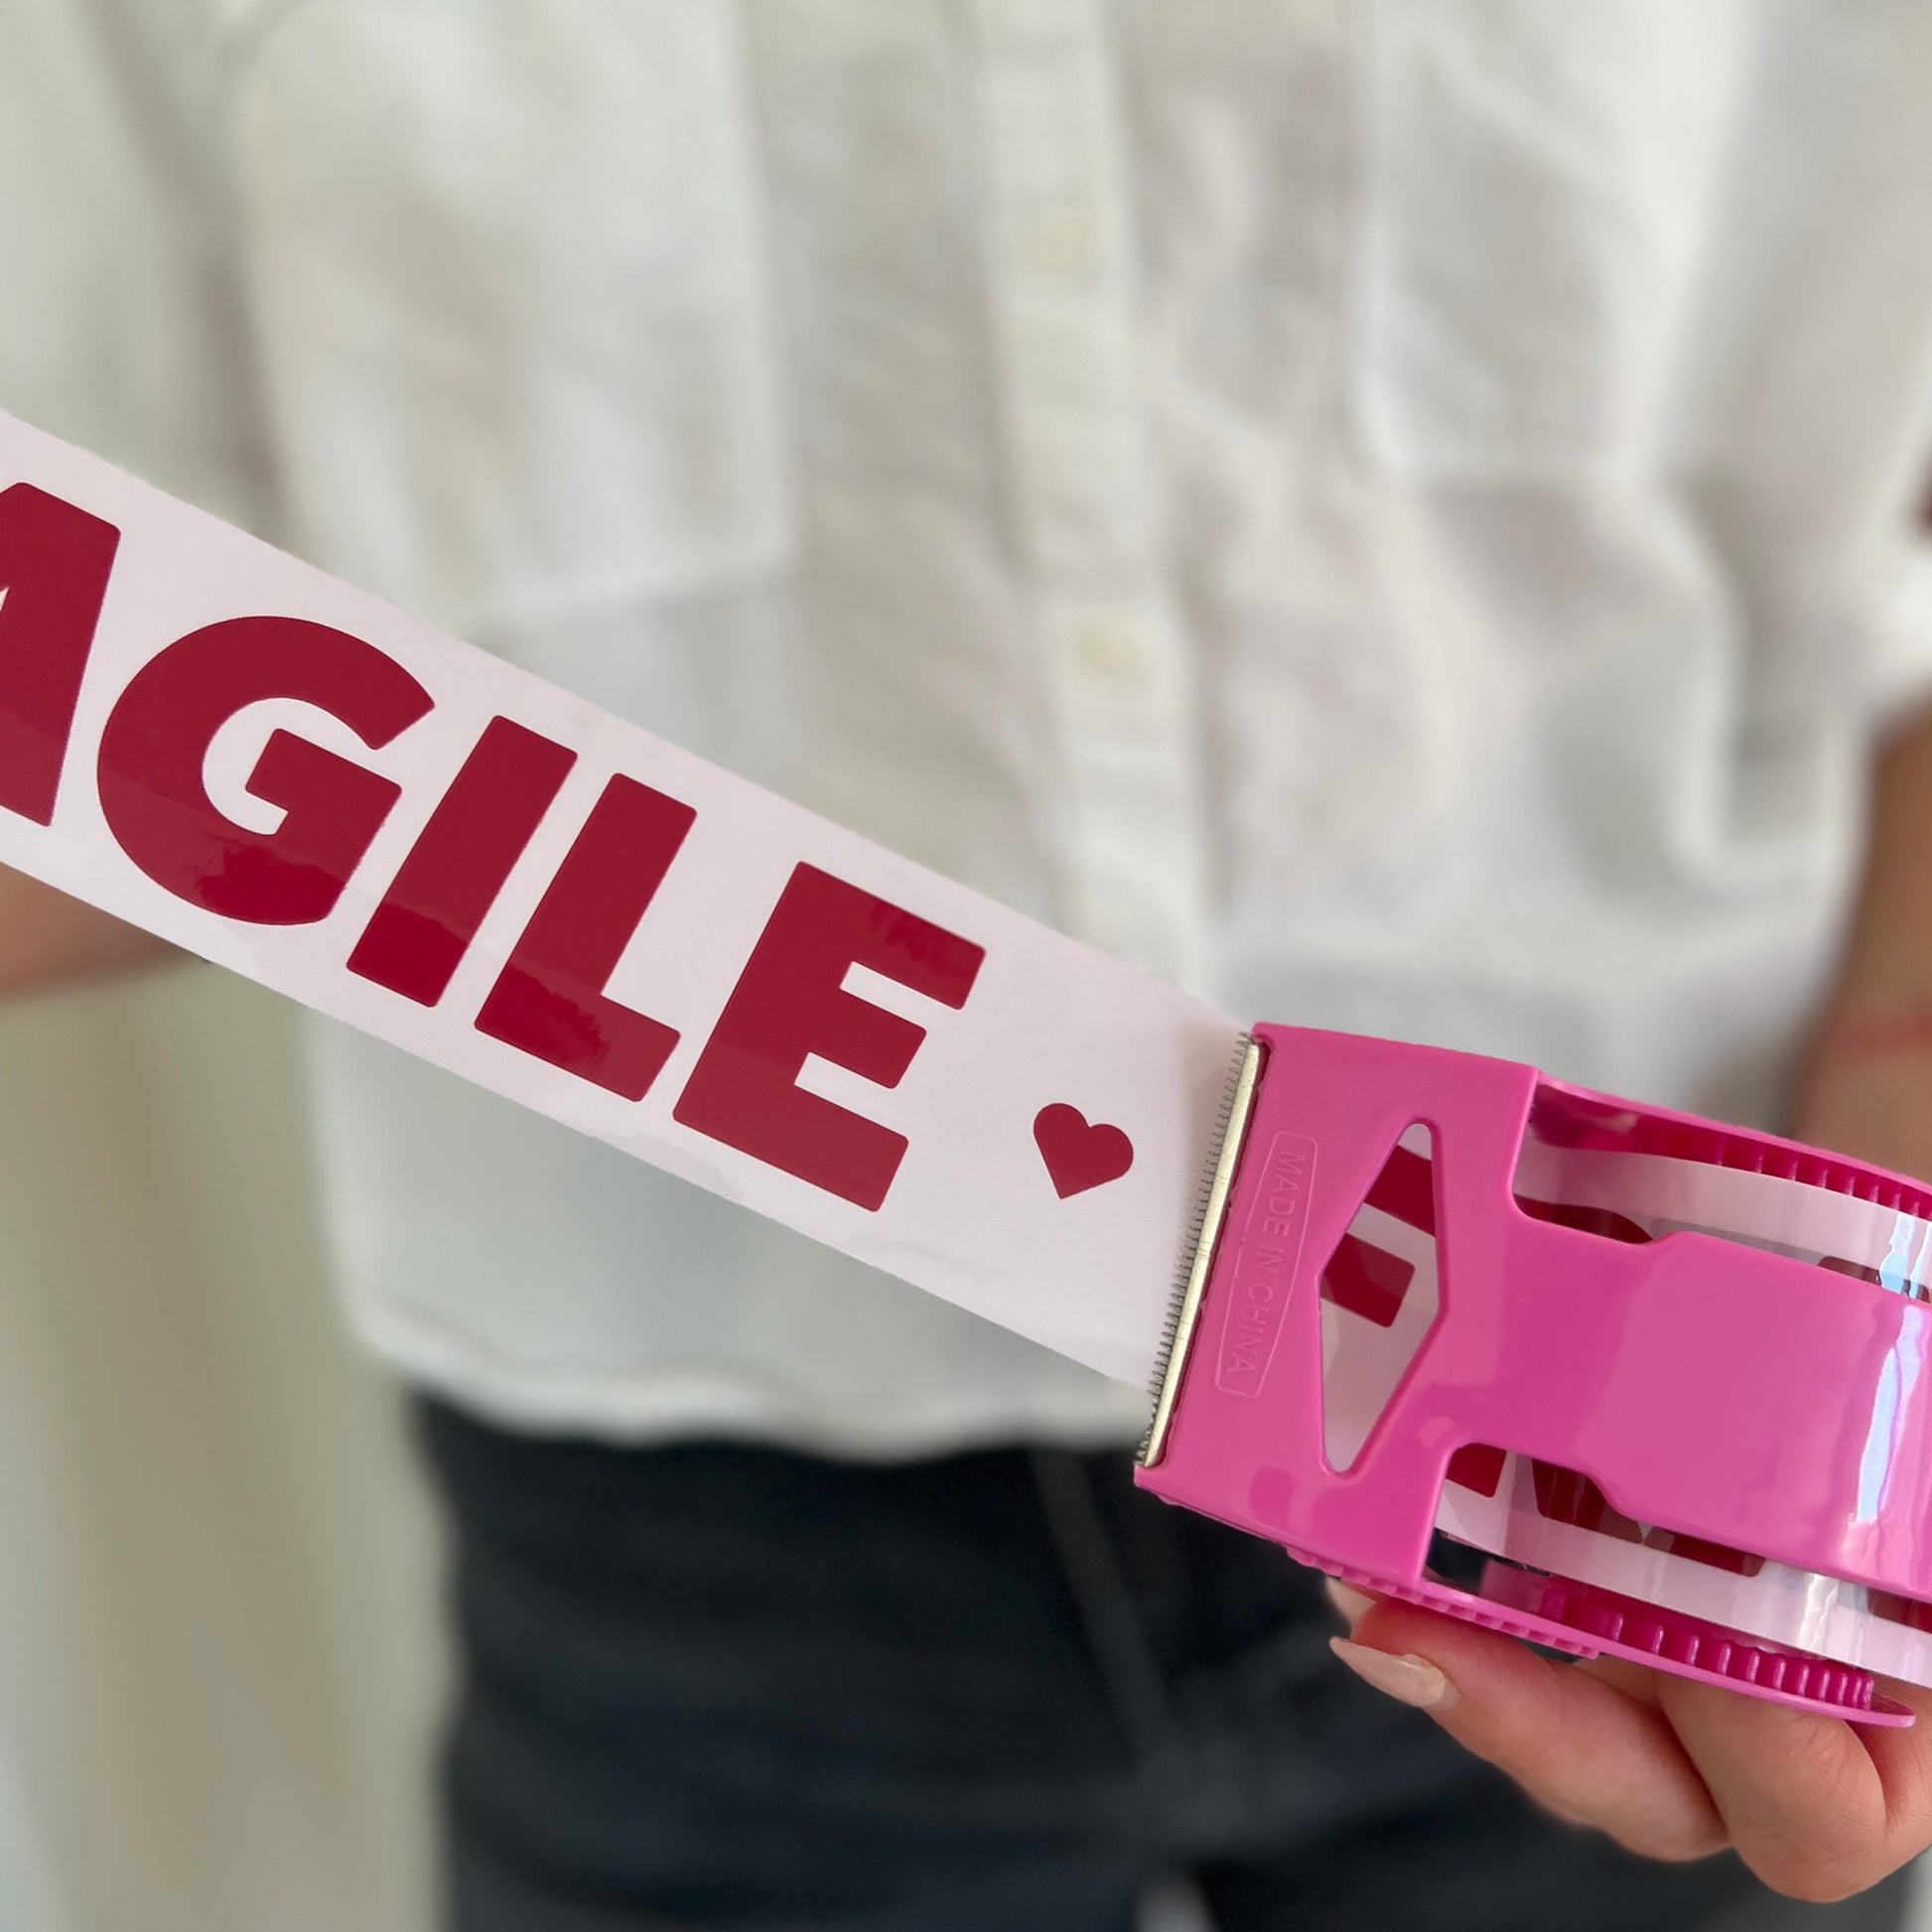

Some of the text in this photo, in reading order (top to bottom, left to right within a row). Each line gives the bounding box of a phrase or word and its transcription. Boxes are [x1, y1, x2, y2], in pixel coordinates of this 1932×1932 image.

[1227, 1150, 1308, 1375] MADE IN CHINA
